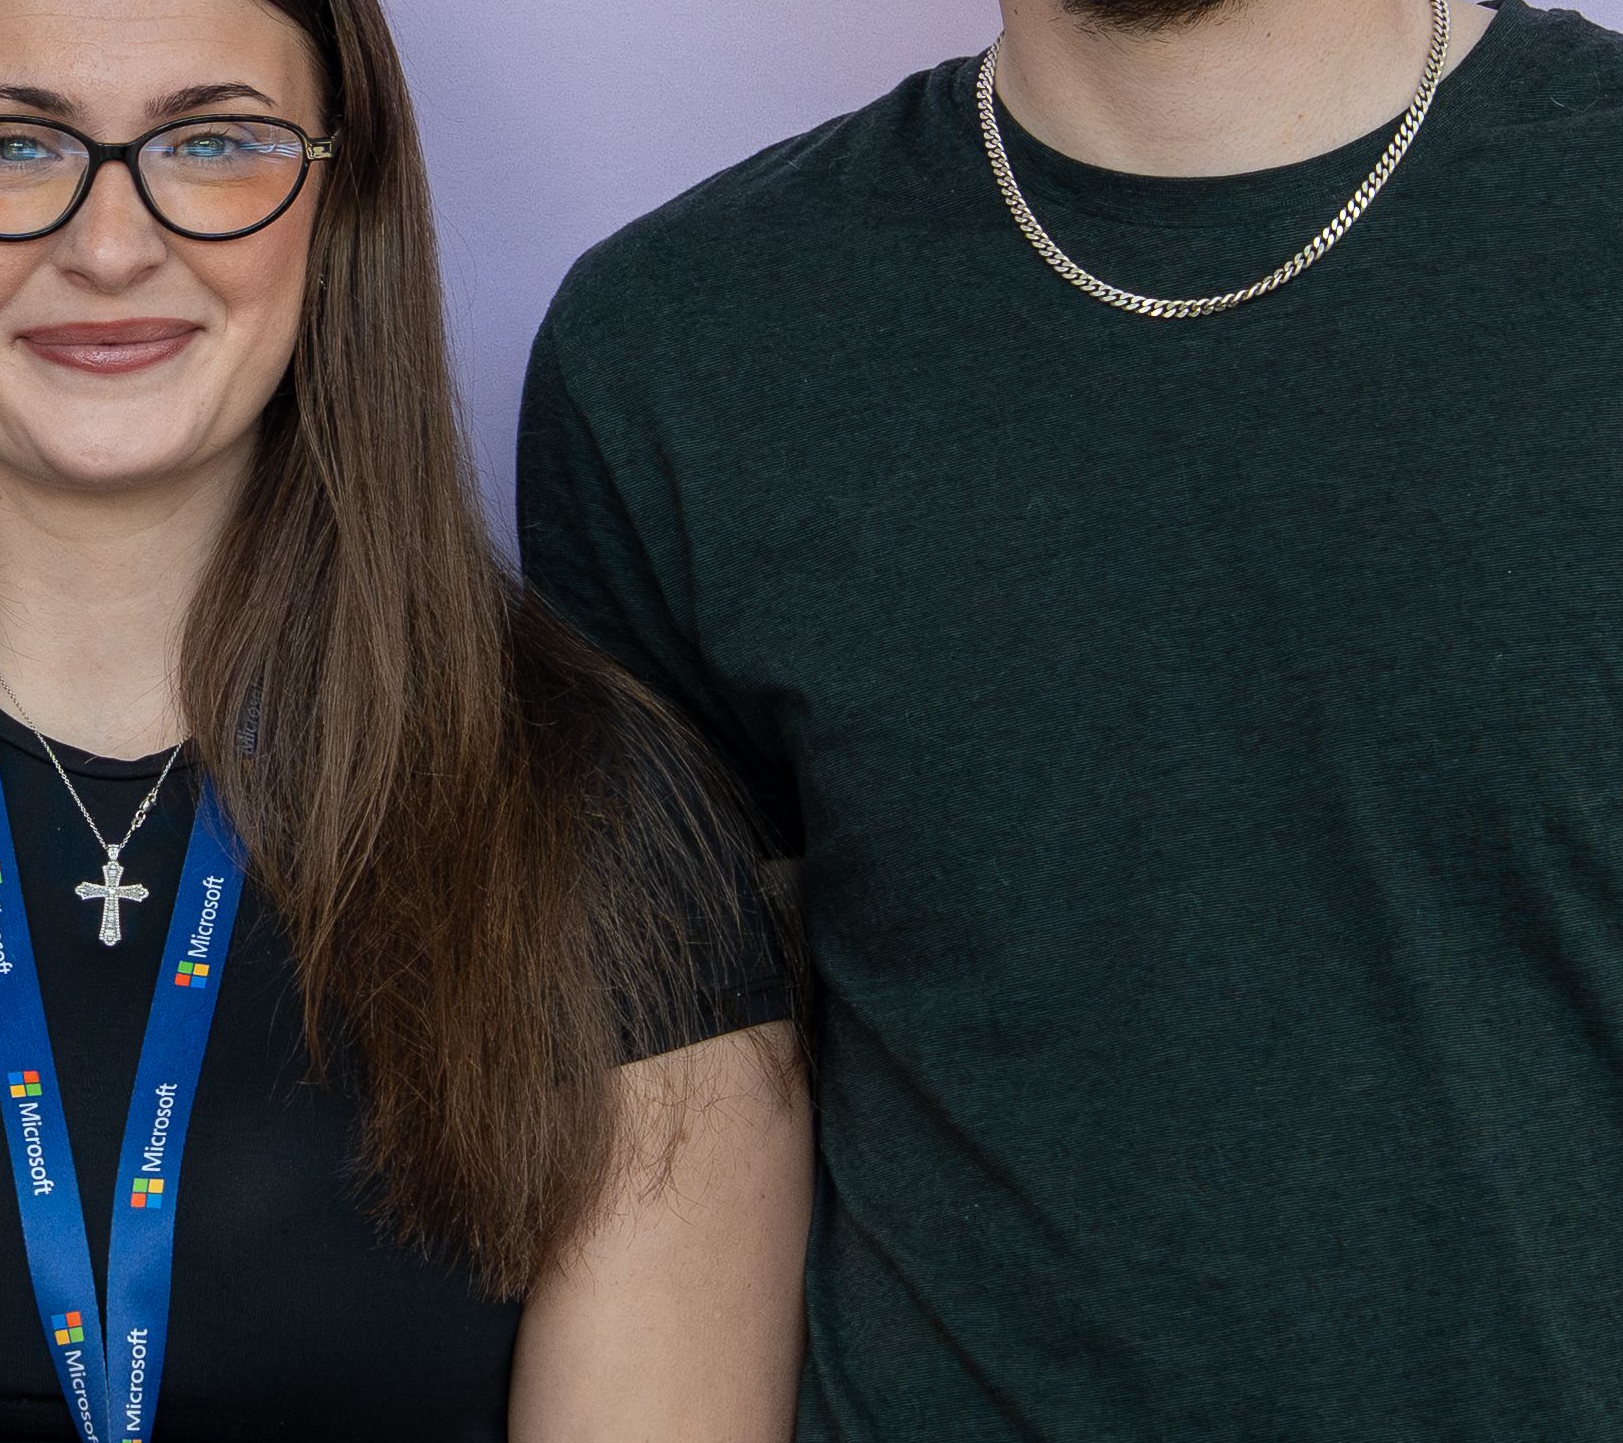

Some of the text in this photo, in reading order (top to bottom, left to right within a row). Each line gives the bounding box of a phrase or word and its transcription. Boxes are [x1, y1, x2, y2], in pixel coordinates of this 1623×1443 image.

[188, 875, 225, 959] Microsoft
[19, 1101, 54, 1197] Microsoft
[141, 1082, 178, 1173] Microsoft
[126, 1328, 149, 1432] Microsoft
